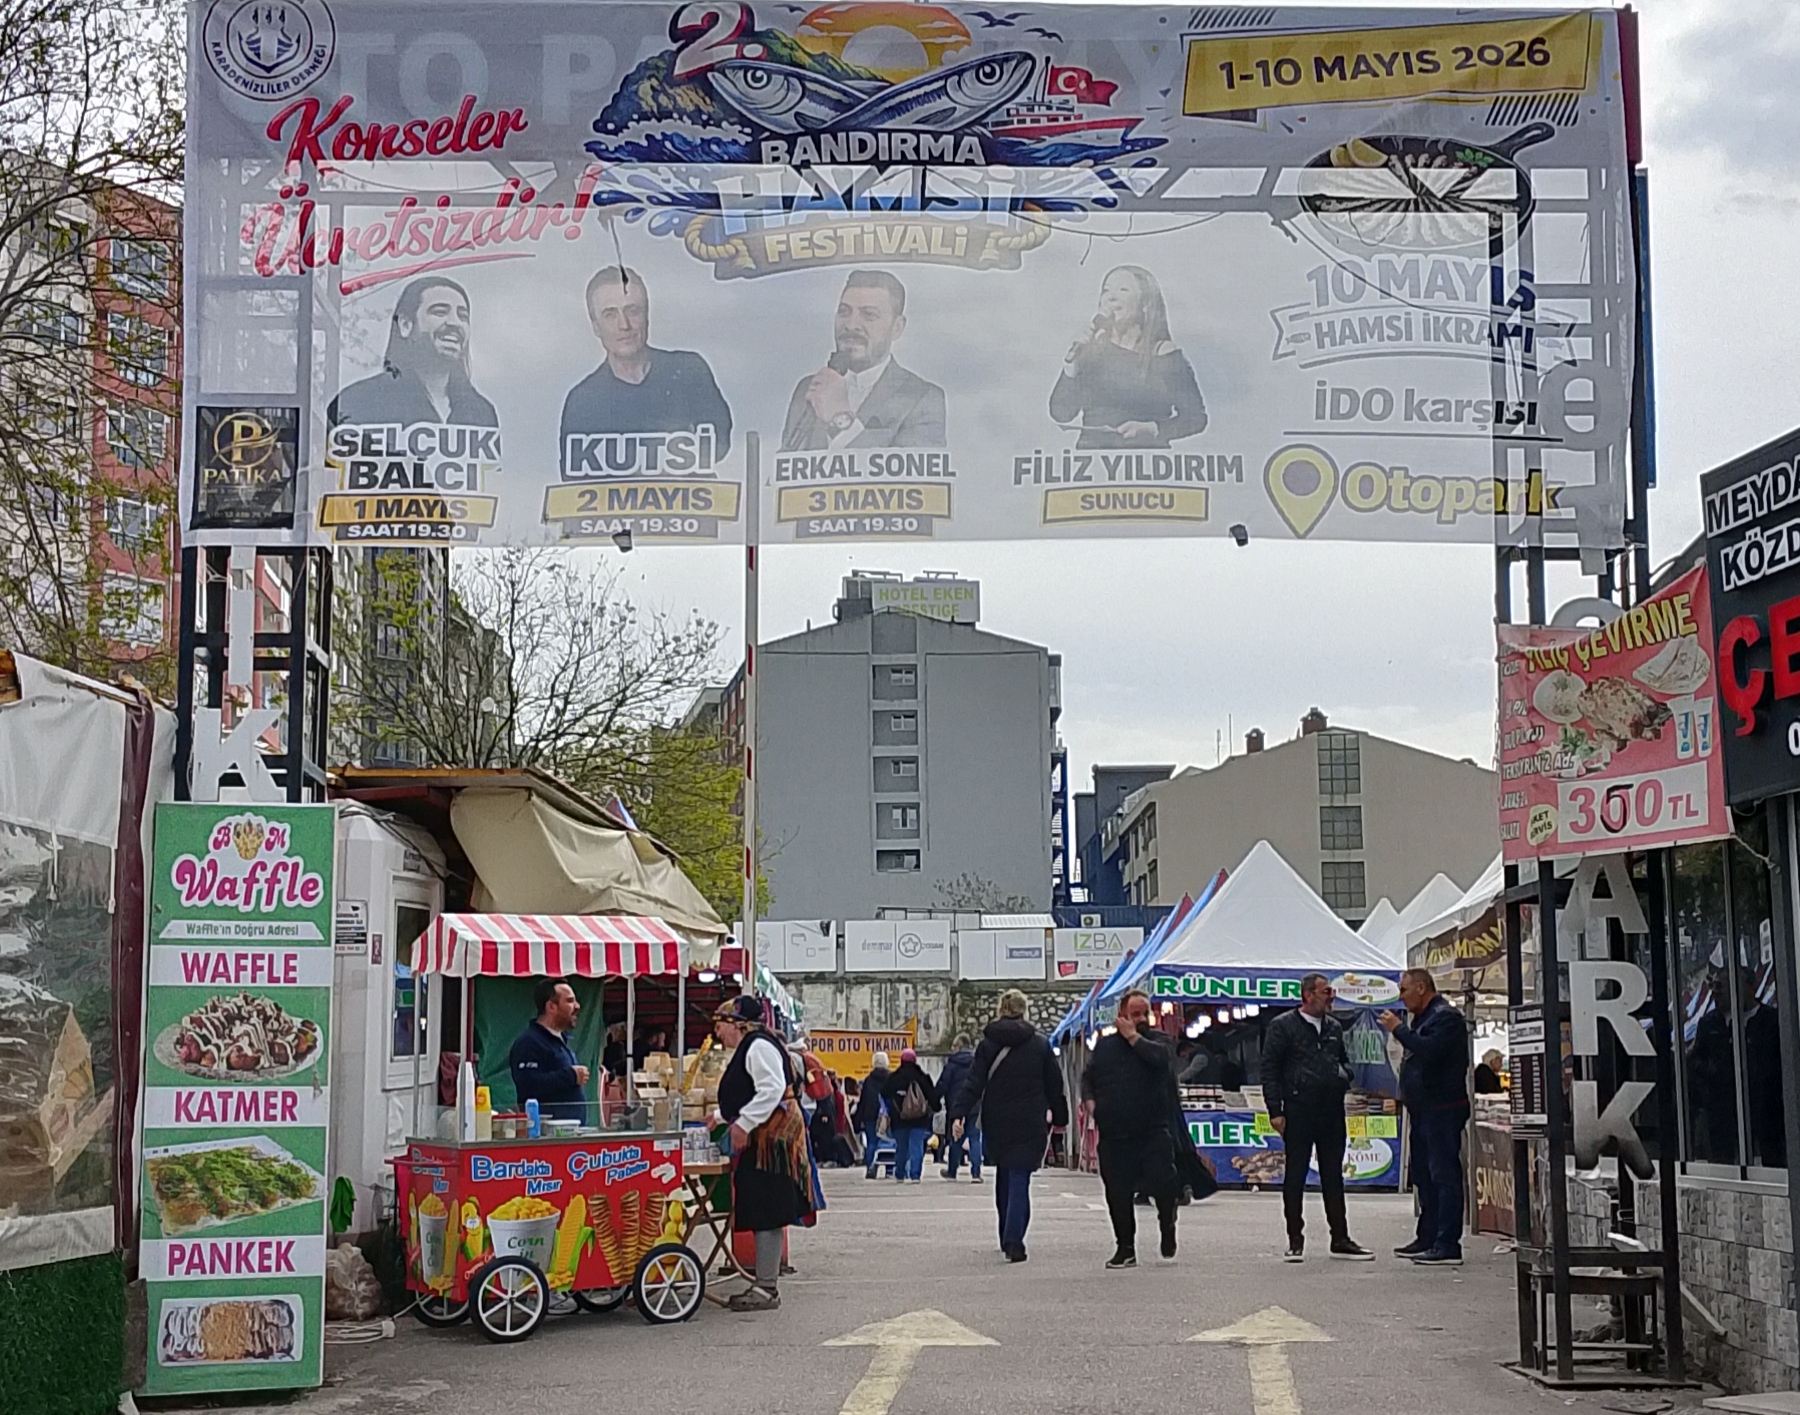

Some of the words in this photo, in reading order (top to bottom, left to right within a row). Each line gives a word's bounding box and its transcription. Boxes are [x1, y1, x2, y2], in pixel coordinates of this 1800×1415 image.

[1218, 58, 1302, 90] 1-10
[1313, 51, 1442, 83] MAYIS
[1451, 37, 1551, 71] 2026
[266, 94, 528, 177] Konseler
[761, 133, 986, 166] BANDIRMA
[240, 163, 603, 278] Ücretsizdir!
[766, 222, 968, 263] FESTİVALİ
[1307, 261, 1366, 307] 10
[1377, 258, 1535, 312] MAYIS
[1314, 311, 1414, 349] HAMSİ
[1422, 312, 1534, 354] İKRAMI
[1314, 379, 1394, 422] İDO
[1404, 387, 1537, 431] karşısı
[331, 426, 499, 462] SELÇUK
[570, 427, 712, 472] KUTSİ
[349, 461, 478, 491] BALCI
[775, 454, 863, 482] ERKAL
[868, 453, 957, 478] SONEL
[1013, 449, 1093, 486] FİLİZ
[1100, 454, 1244, 483] YILDIRIM
[577, 489, 598, 512] 2
[607, 487, 713, 511] MAYIS
[808, 491, 827, 512] 3
[833, 488, 924, 512] MAYIS
[1080, 492, 1175, 511] SUNUCU
[1342, 461, 1562, 524] Otopark
[353, 499, 364, 519] 1
[375, 499, 468, 520] MAYIS
[808, 518, 858, 534] SAAT
[862, 517, 919, 532] 19.30
[347, 524, 403, 537] SAAT
[407, 524, 467, 538] 19.30
[581, 519, 636, 534] SAAT
[639, 519, 699, 533] 19.30
[879, 587, 929, 601] HOTEL
[932, 587, 975, 601] EKEN
[1668, 793, 1700, 820] TL
[212, 823, 231, 851] B
[264, 827, 288, 852] M
[175, 858, 320, 907] Waffle
[234, 923, 265, 938] Doğru
[268, 923, 299, 936] Adresi
[181, 952, 298, 984] WAFFLE
[838, 1038, 861, 1052] OTO
[865, 1036, 908, 1052] YIKAMA
[174, 1091, 298, 1123] KATMER
[471, 1155, 552, 1181] Bardakta
[567, 1146, 641, 1180] Çubukta
[167, 1241, 296, 1277] PANKEK
[507, 1236, 545, 1250] Corn
